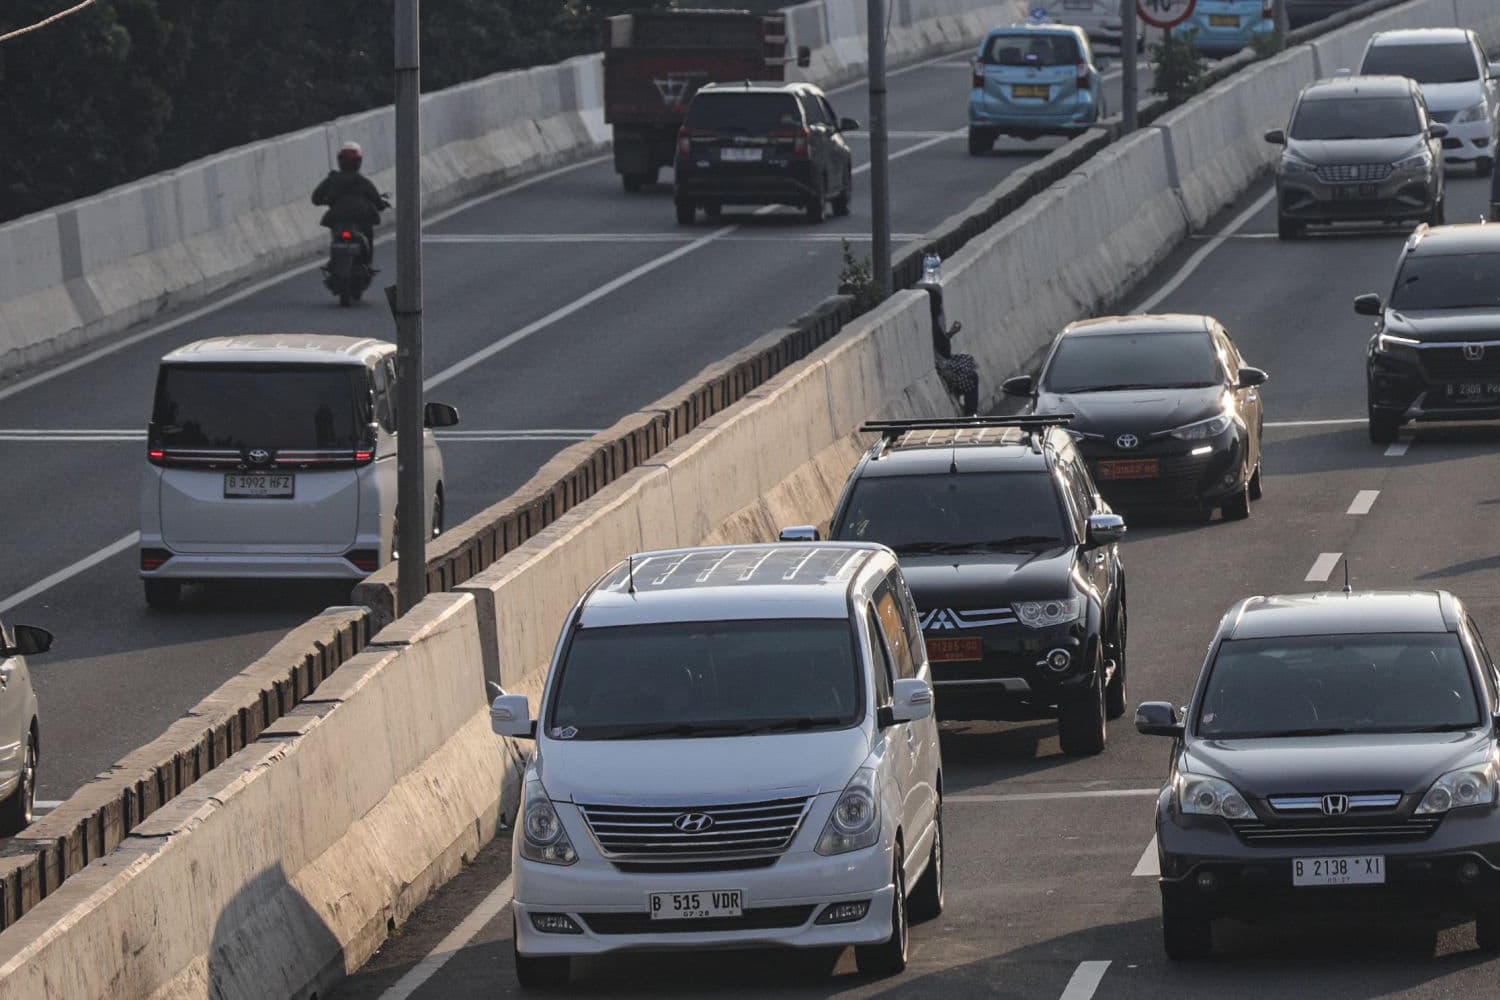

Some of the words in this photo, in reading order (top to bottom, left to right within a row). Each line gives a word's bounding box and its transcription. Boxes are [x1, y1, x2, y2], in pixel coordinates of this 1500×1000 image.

[229, 476, 236, 489] B
[239, 476, 266, 489] 1992
[1295, 860, 1304, 877] B
[1313, 859, 1348, 876] 2138
[1365, 858, 1380, 874] XI
[652, 895, 661, 911] B
[673, 894, 700, 911] 515
[711, 892, 739, 909] VDR
